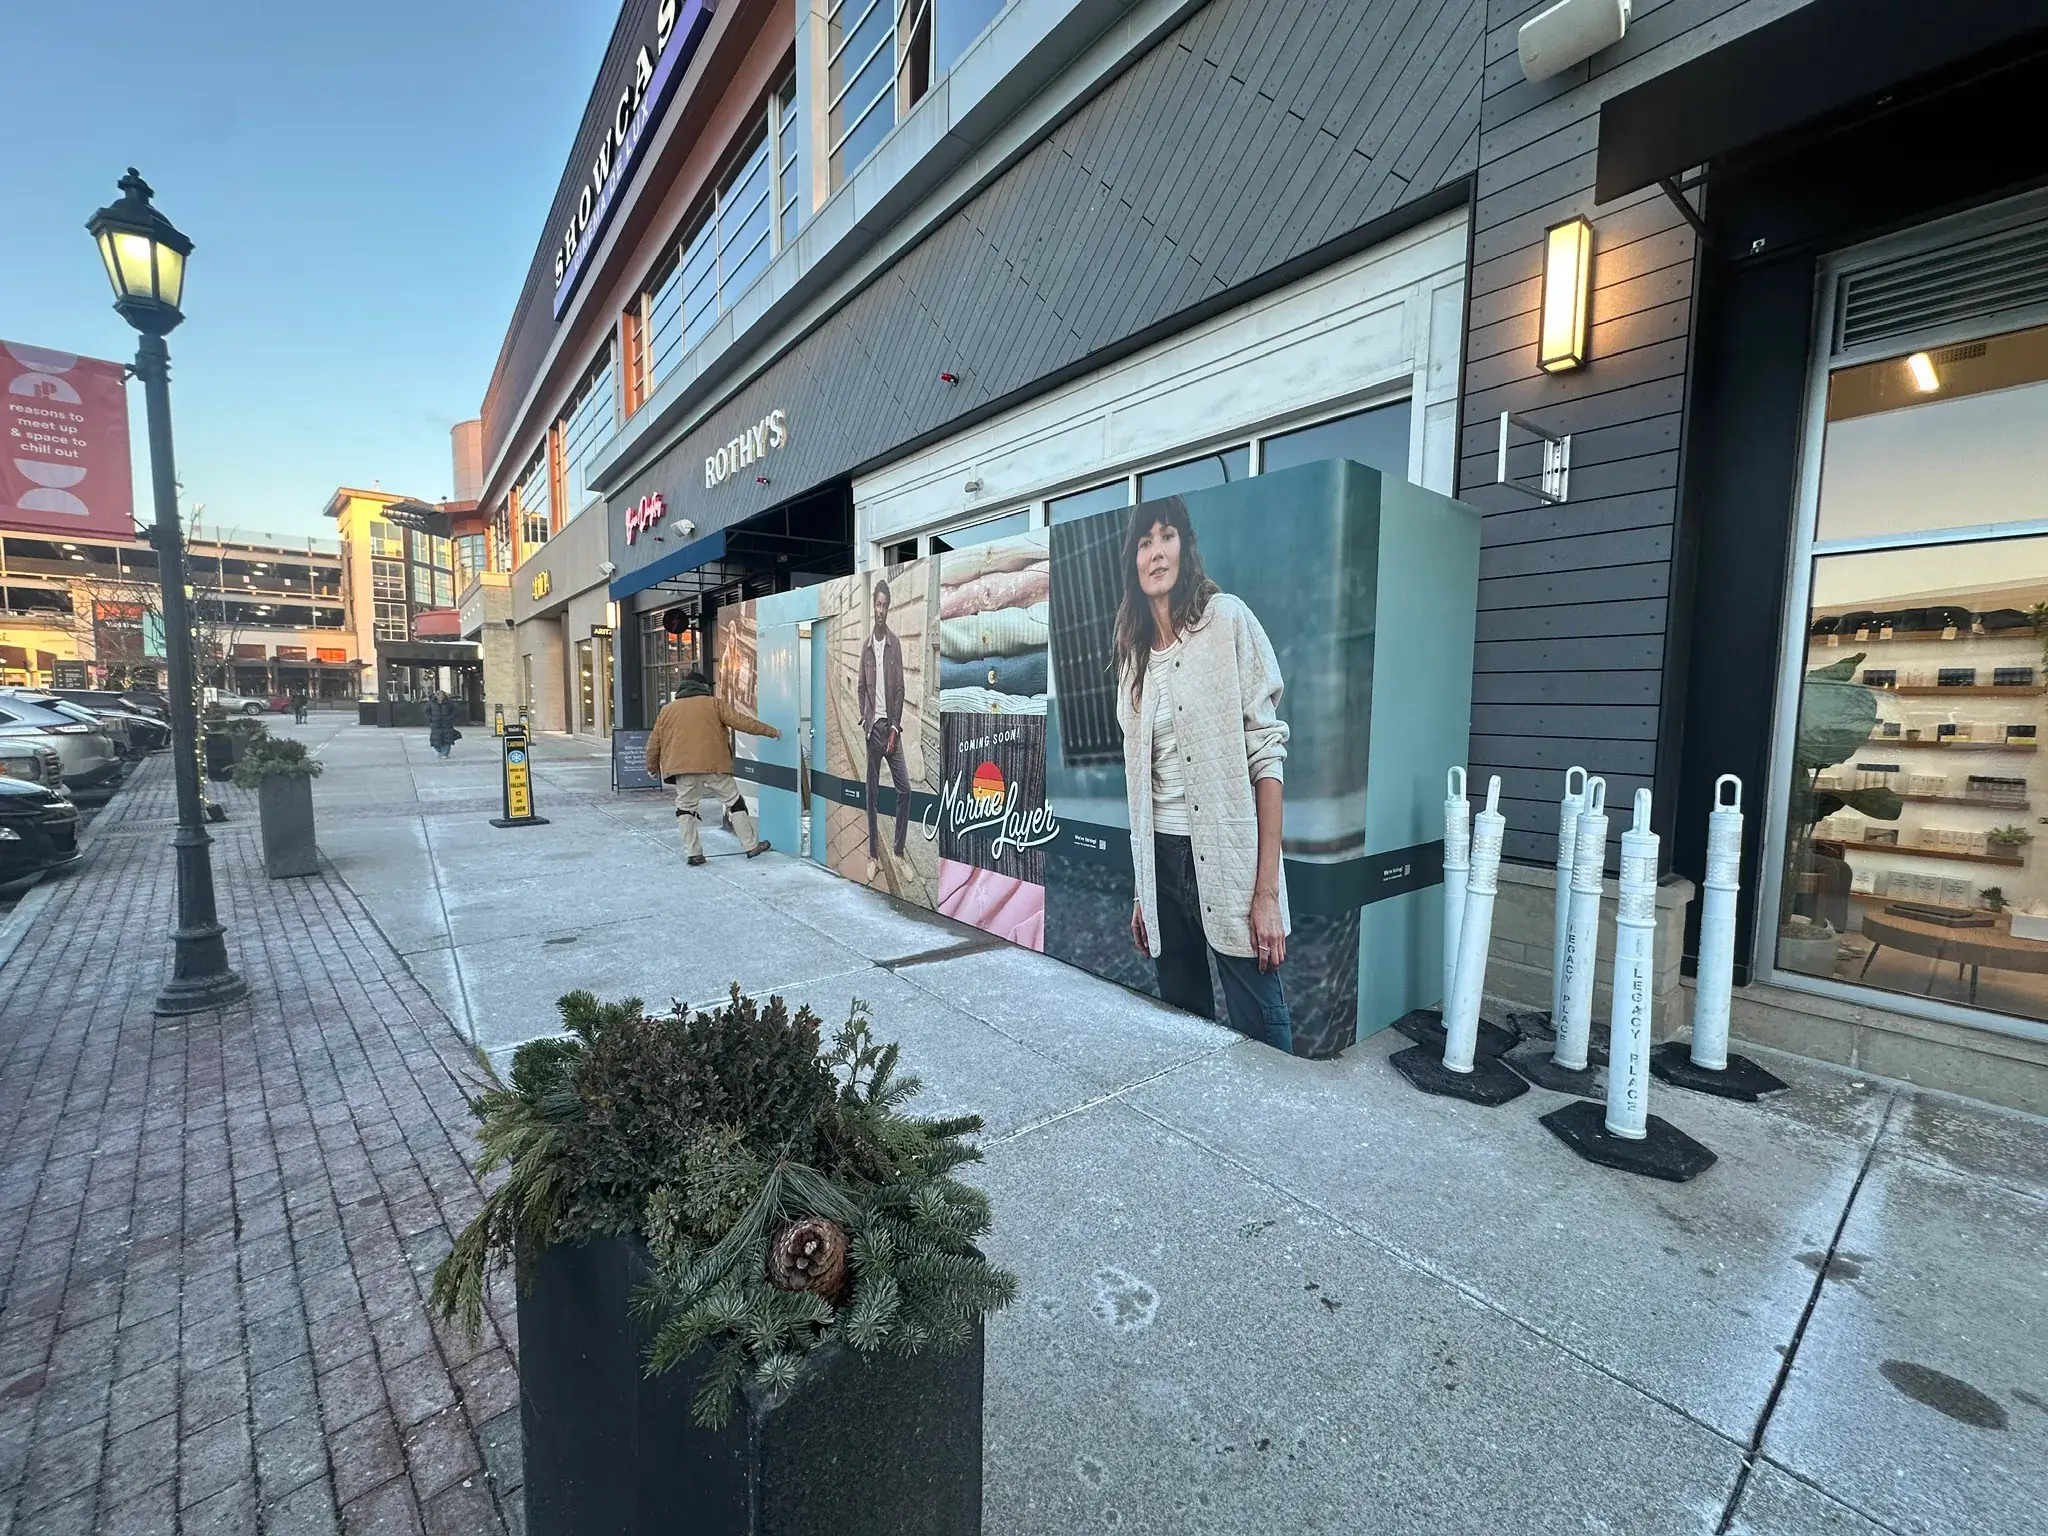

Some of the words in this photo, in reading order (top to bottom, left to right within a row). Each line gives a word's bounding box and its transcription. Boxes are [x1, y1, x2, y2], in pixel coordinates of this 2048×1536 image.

[573, 195, 607, 271] CINEMA
[609, 154, 624, 195] DE
[625, 94, 650, 160] LUX
[8, 403, 67, 419] reasons
[69, 411, 84, 423] to
[17, 417, 56, 431] meet
[59, 423, 78, 435] up
[10, 427, 22, 437] &
[25, 432, 69, 445] space
[72, 438, 87, 448] to
[20, 442, 51, 455] chill
[54, 448, 80, 459] out
[705, 409, 786, 489] ROTHY'S
[959, 735, 990, 753] COMING
[992, 727, 1020, 745] SOON!
[923, 770, 1003, 840] Marine
[986, 781, 1060, 860] Layer
[1630, 967, 1644, 1041] LEGACY
[1627, 1052, 1639, 1113] PLACE
